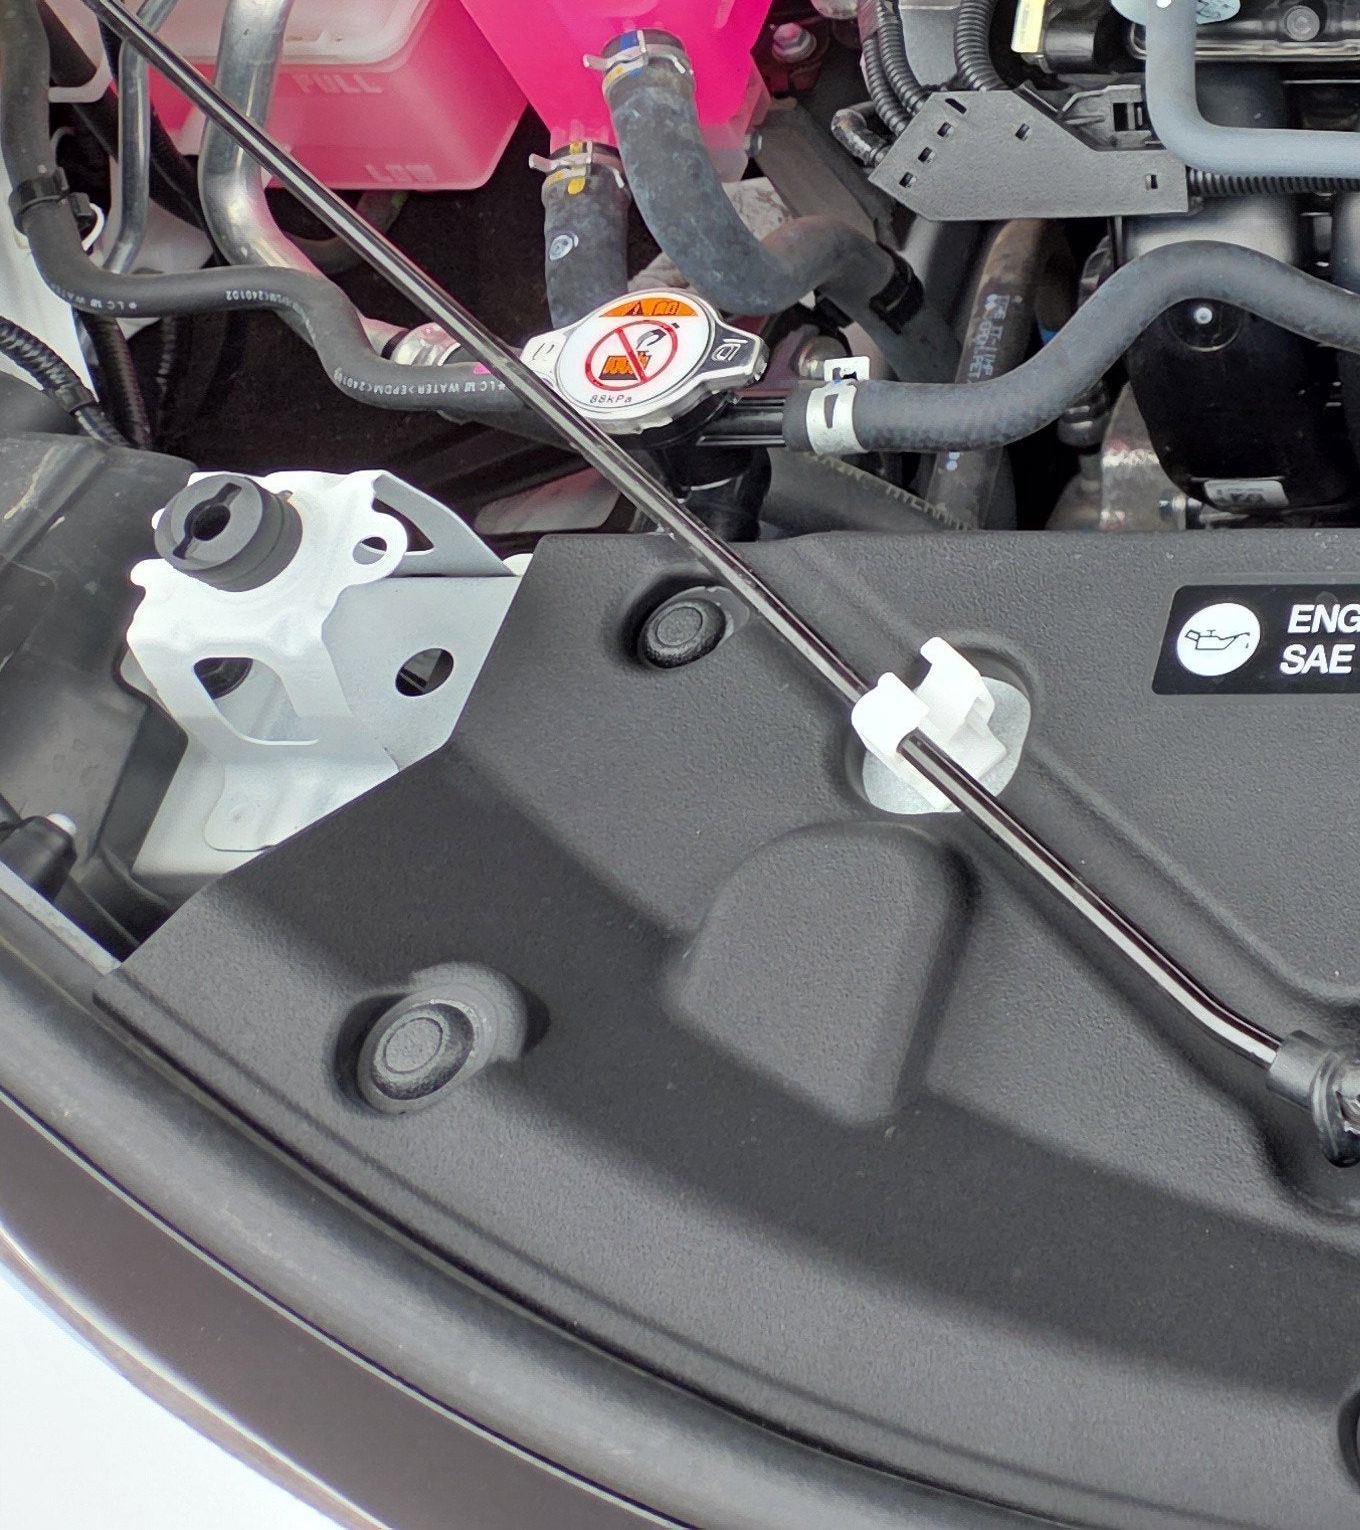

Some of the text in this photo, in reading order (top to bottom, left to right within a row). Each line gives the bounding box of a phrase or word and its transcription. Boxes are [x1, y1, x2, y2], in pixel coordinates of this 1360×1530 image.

[292, 74, 383, 94] FULL
[588, 393, 634, 405] 88kPa
[1279, 643, 1357, 675] SAE
